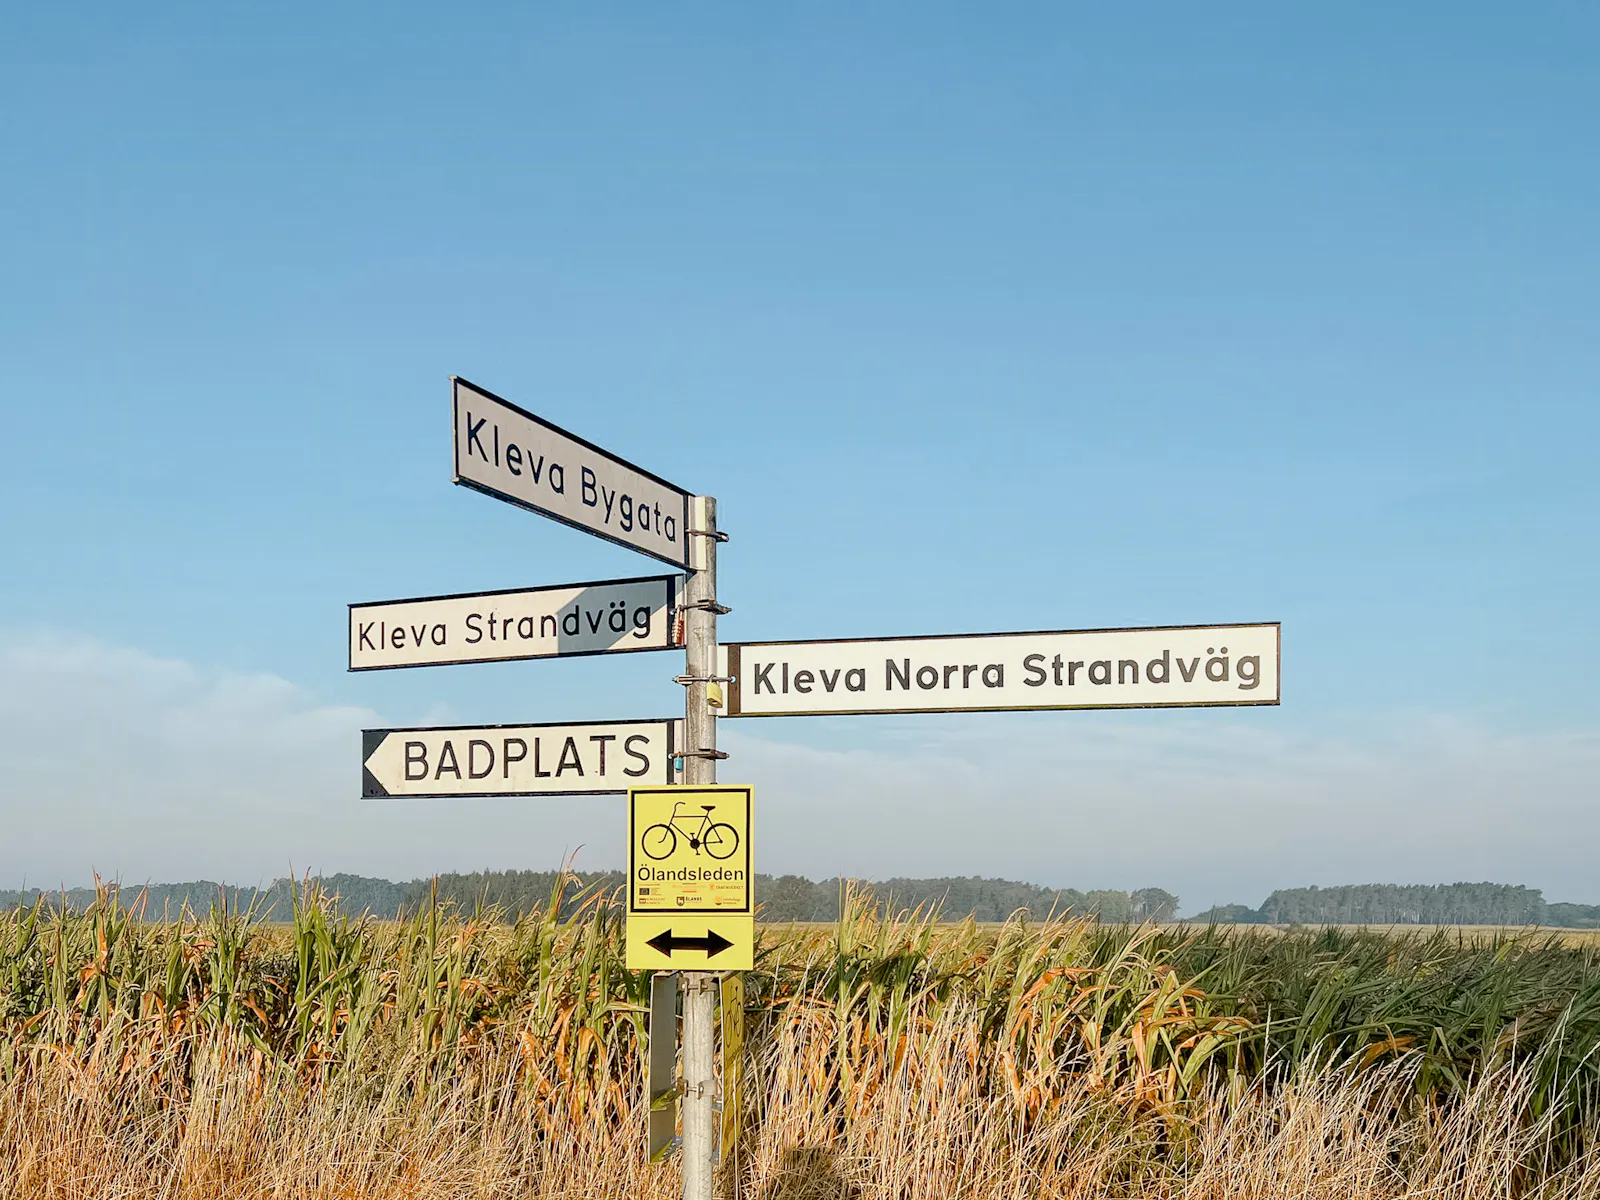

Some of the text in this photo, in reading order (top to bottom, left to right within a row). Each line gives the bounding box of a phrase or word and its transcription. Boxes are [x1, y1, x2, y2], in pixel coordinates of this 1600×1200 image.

[466, 411, 676, 543] Kleva Bygata
[359, 599, 651, 652] Kleva Strandväg
[754, 646, 1260, 695] Kleva Norra Strandväg
[405, 734, 650, 781] BADPLATS
[637, 863, 744, 881] Ölandsleden
